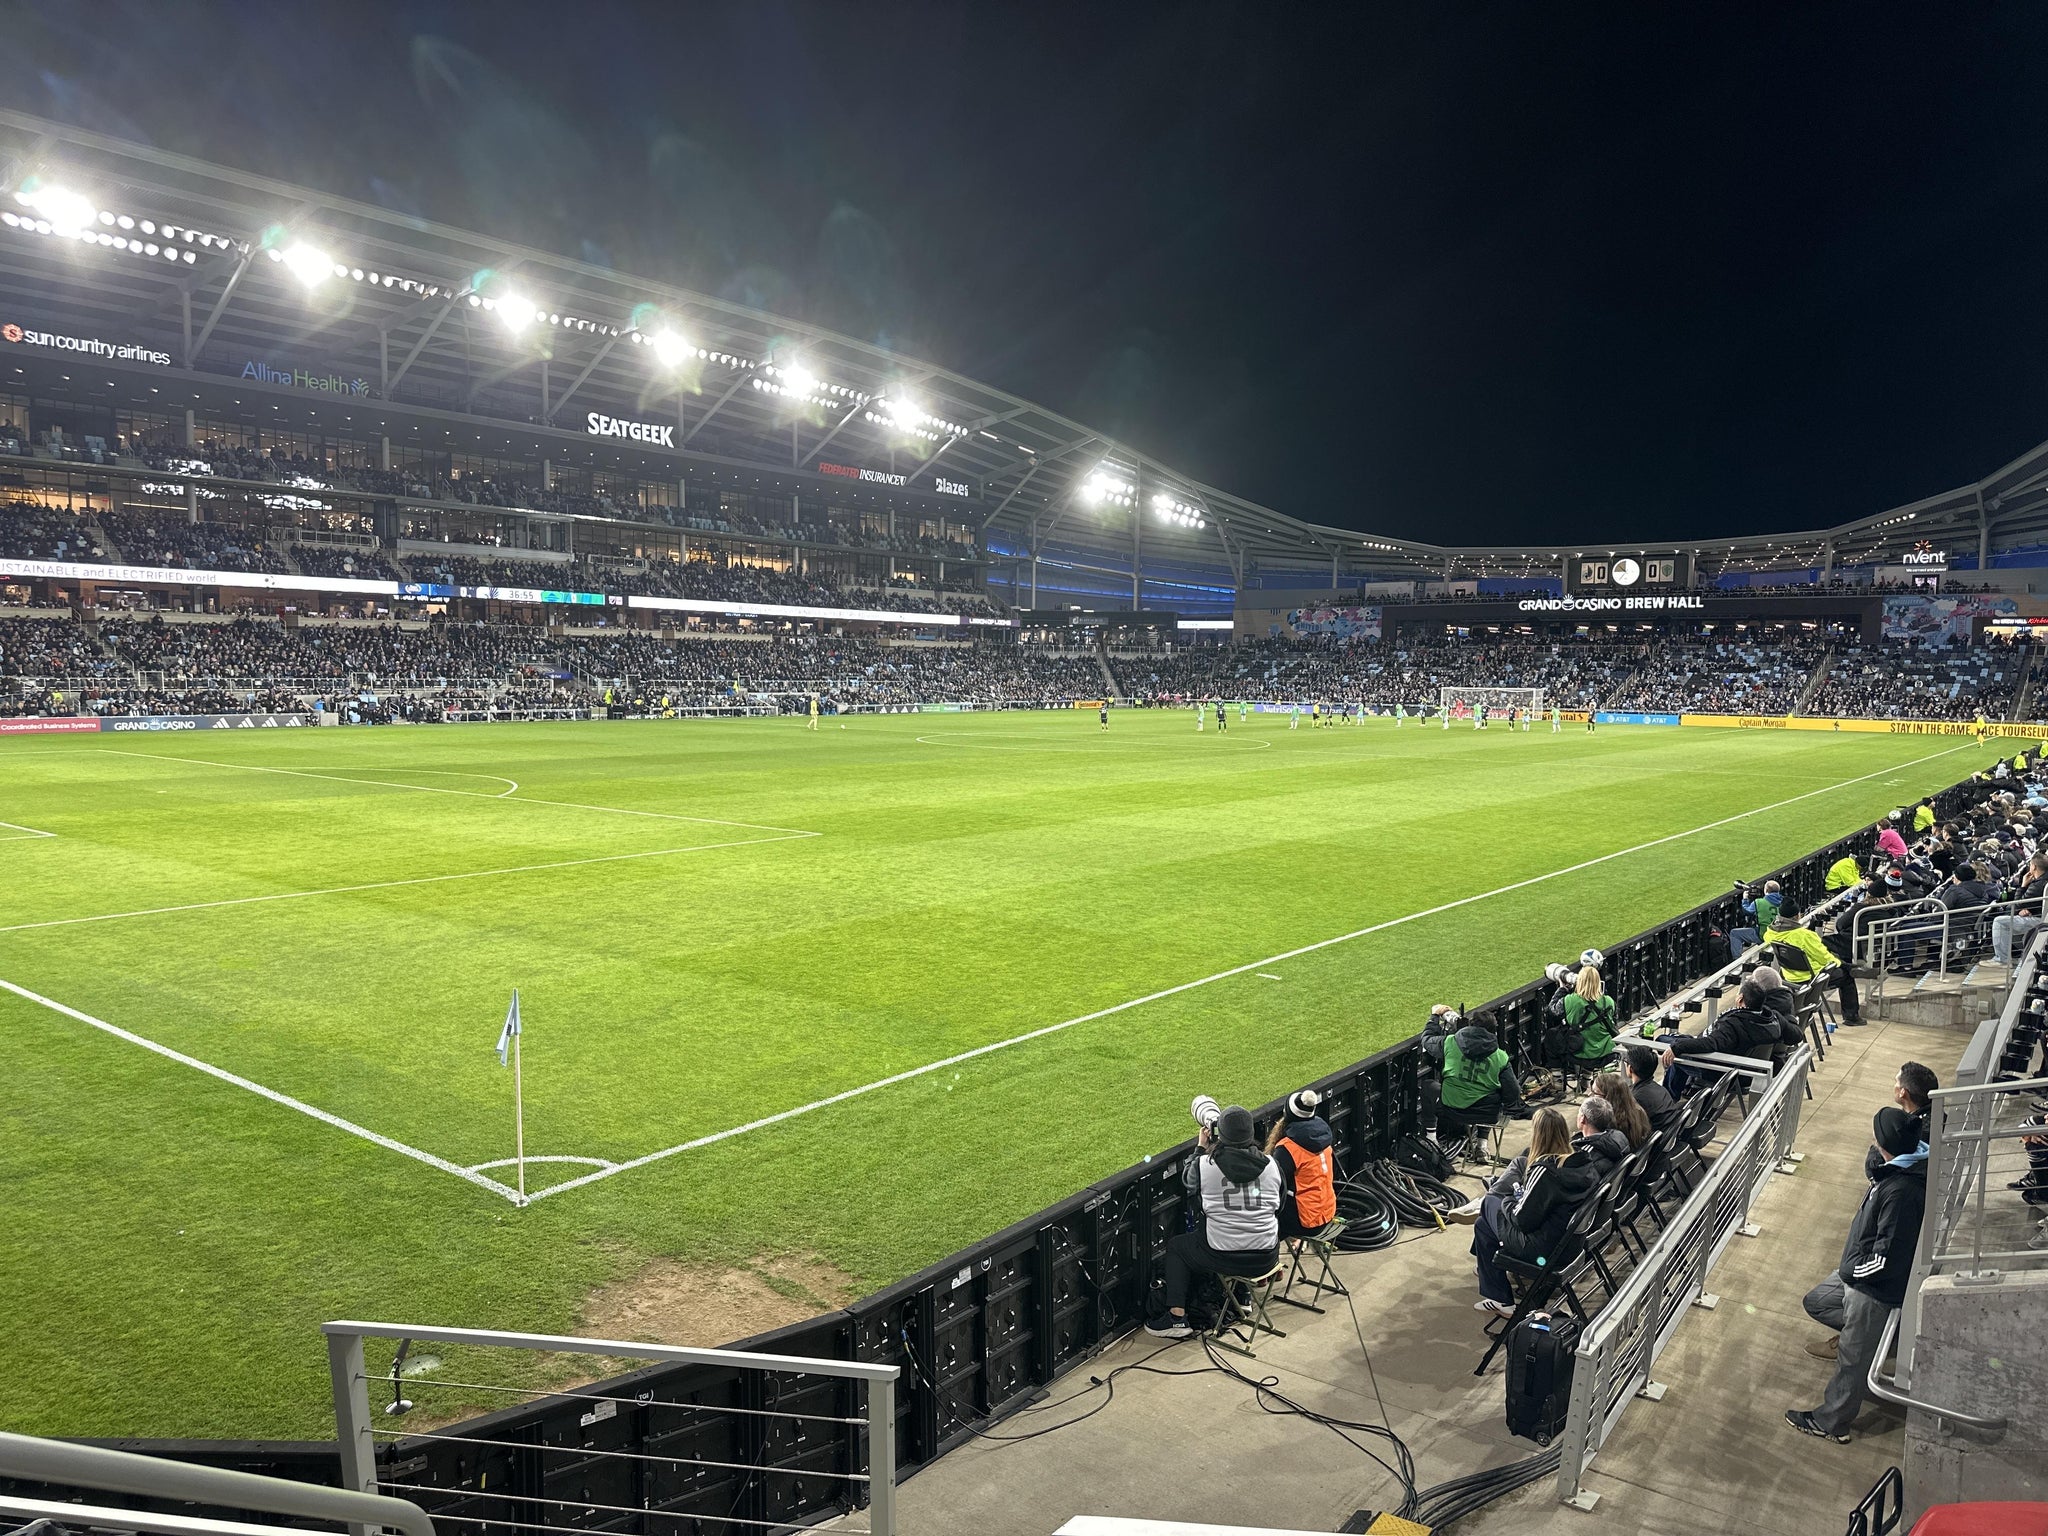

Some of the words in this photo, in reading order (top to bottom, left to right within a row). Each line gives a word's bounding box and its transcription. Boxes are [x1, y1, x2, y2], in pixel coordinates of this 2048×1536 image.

[24, 330, 55, 347] sun
[56, 335, 116, 359] country
[118, 344, 171, 365] airlines
[241, 361, 292, 385] Allina
[294, 368, 349, 395] Health
[587, 412, 675, 449] SEATGEEK
[818, 462, 860, 479] FEDERATED
[859, 468, 901, 486] INSURANCE
[83, 568, 105, 578] and
[108, 569, 183, 581] ELECTRIFIED
[187, 574, 217, 583] world
[509, 589, 534, 600] 36:55
[1518, 599, 1562, 611] GRAND
[1575, 598, 1621, 611] CASINO
[1625, 597, 1664, 609] BREW
[1667, 596, 1704, 608] HALL
[114, 722, 150, 731] GRAND
[161, 720, 196, 730] CASINO
[1739, 718, 1762, 728] Captain
[1761, 719, 1787, 729] Morgan
[1890, 722, 1912, 733] STAY
[1913, 723, 1923, 734] IN
[1924, 723, 1941, 734] THE
[1944, 724, 1974, 735] GAME.
[1977, 725, 2000, 736] ACE
[1221, 1176, 1262, 1211] 20
